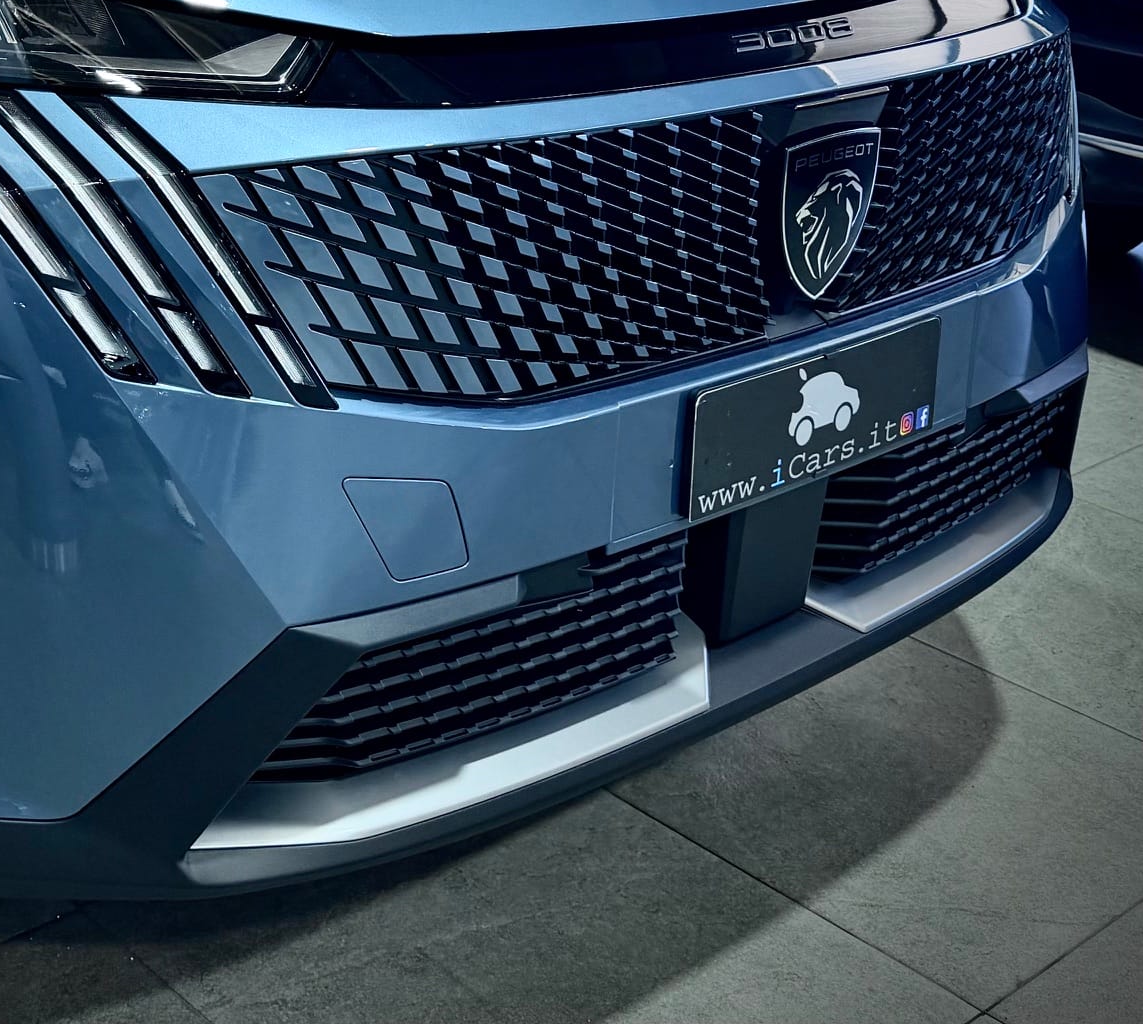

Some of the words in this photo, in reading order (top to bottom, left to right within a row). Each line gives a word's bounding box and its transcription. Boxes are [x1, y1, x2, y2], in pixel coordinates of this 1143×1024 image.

[732, 17, 853, 53] 3008
[794, 142, 874, 173] PEUGEOT
[698, 419, 897, 514] www.iCars.it
